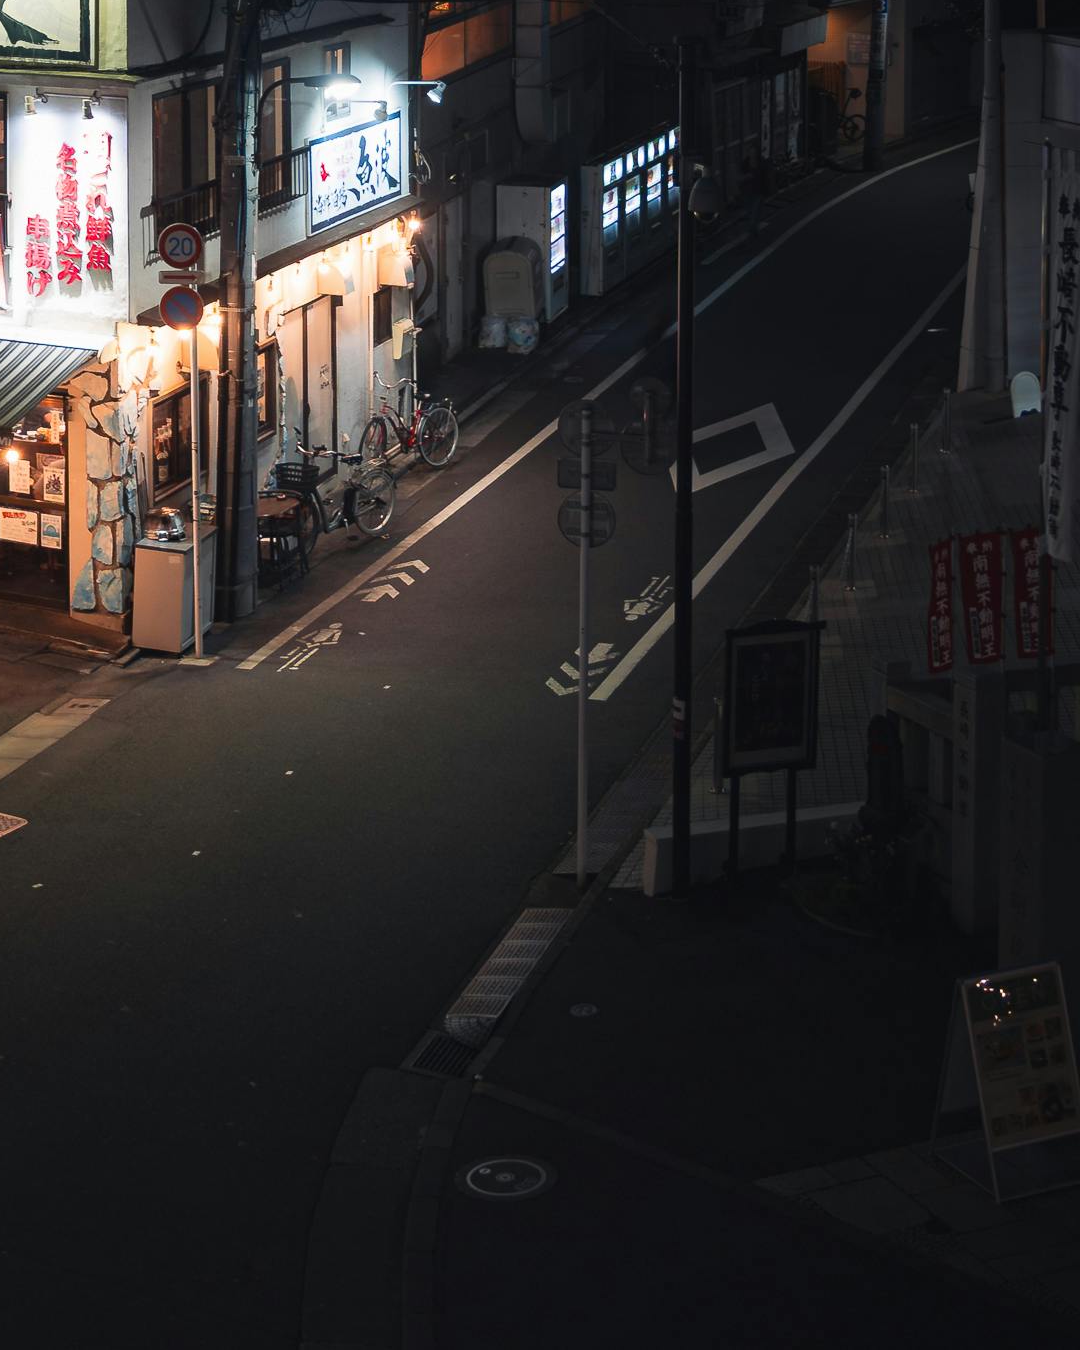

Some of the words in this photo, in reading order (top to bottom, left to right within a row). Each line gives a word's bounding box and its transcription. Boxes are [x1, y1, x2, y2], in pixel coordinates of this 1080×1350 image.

[347, 128, 401, 202] 魚波
[56, 142, 83, 286] 名物煮込み
[168, 236, 193, 257] 20
[25, 213, 53, 298] 串揚げ
